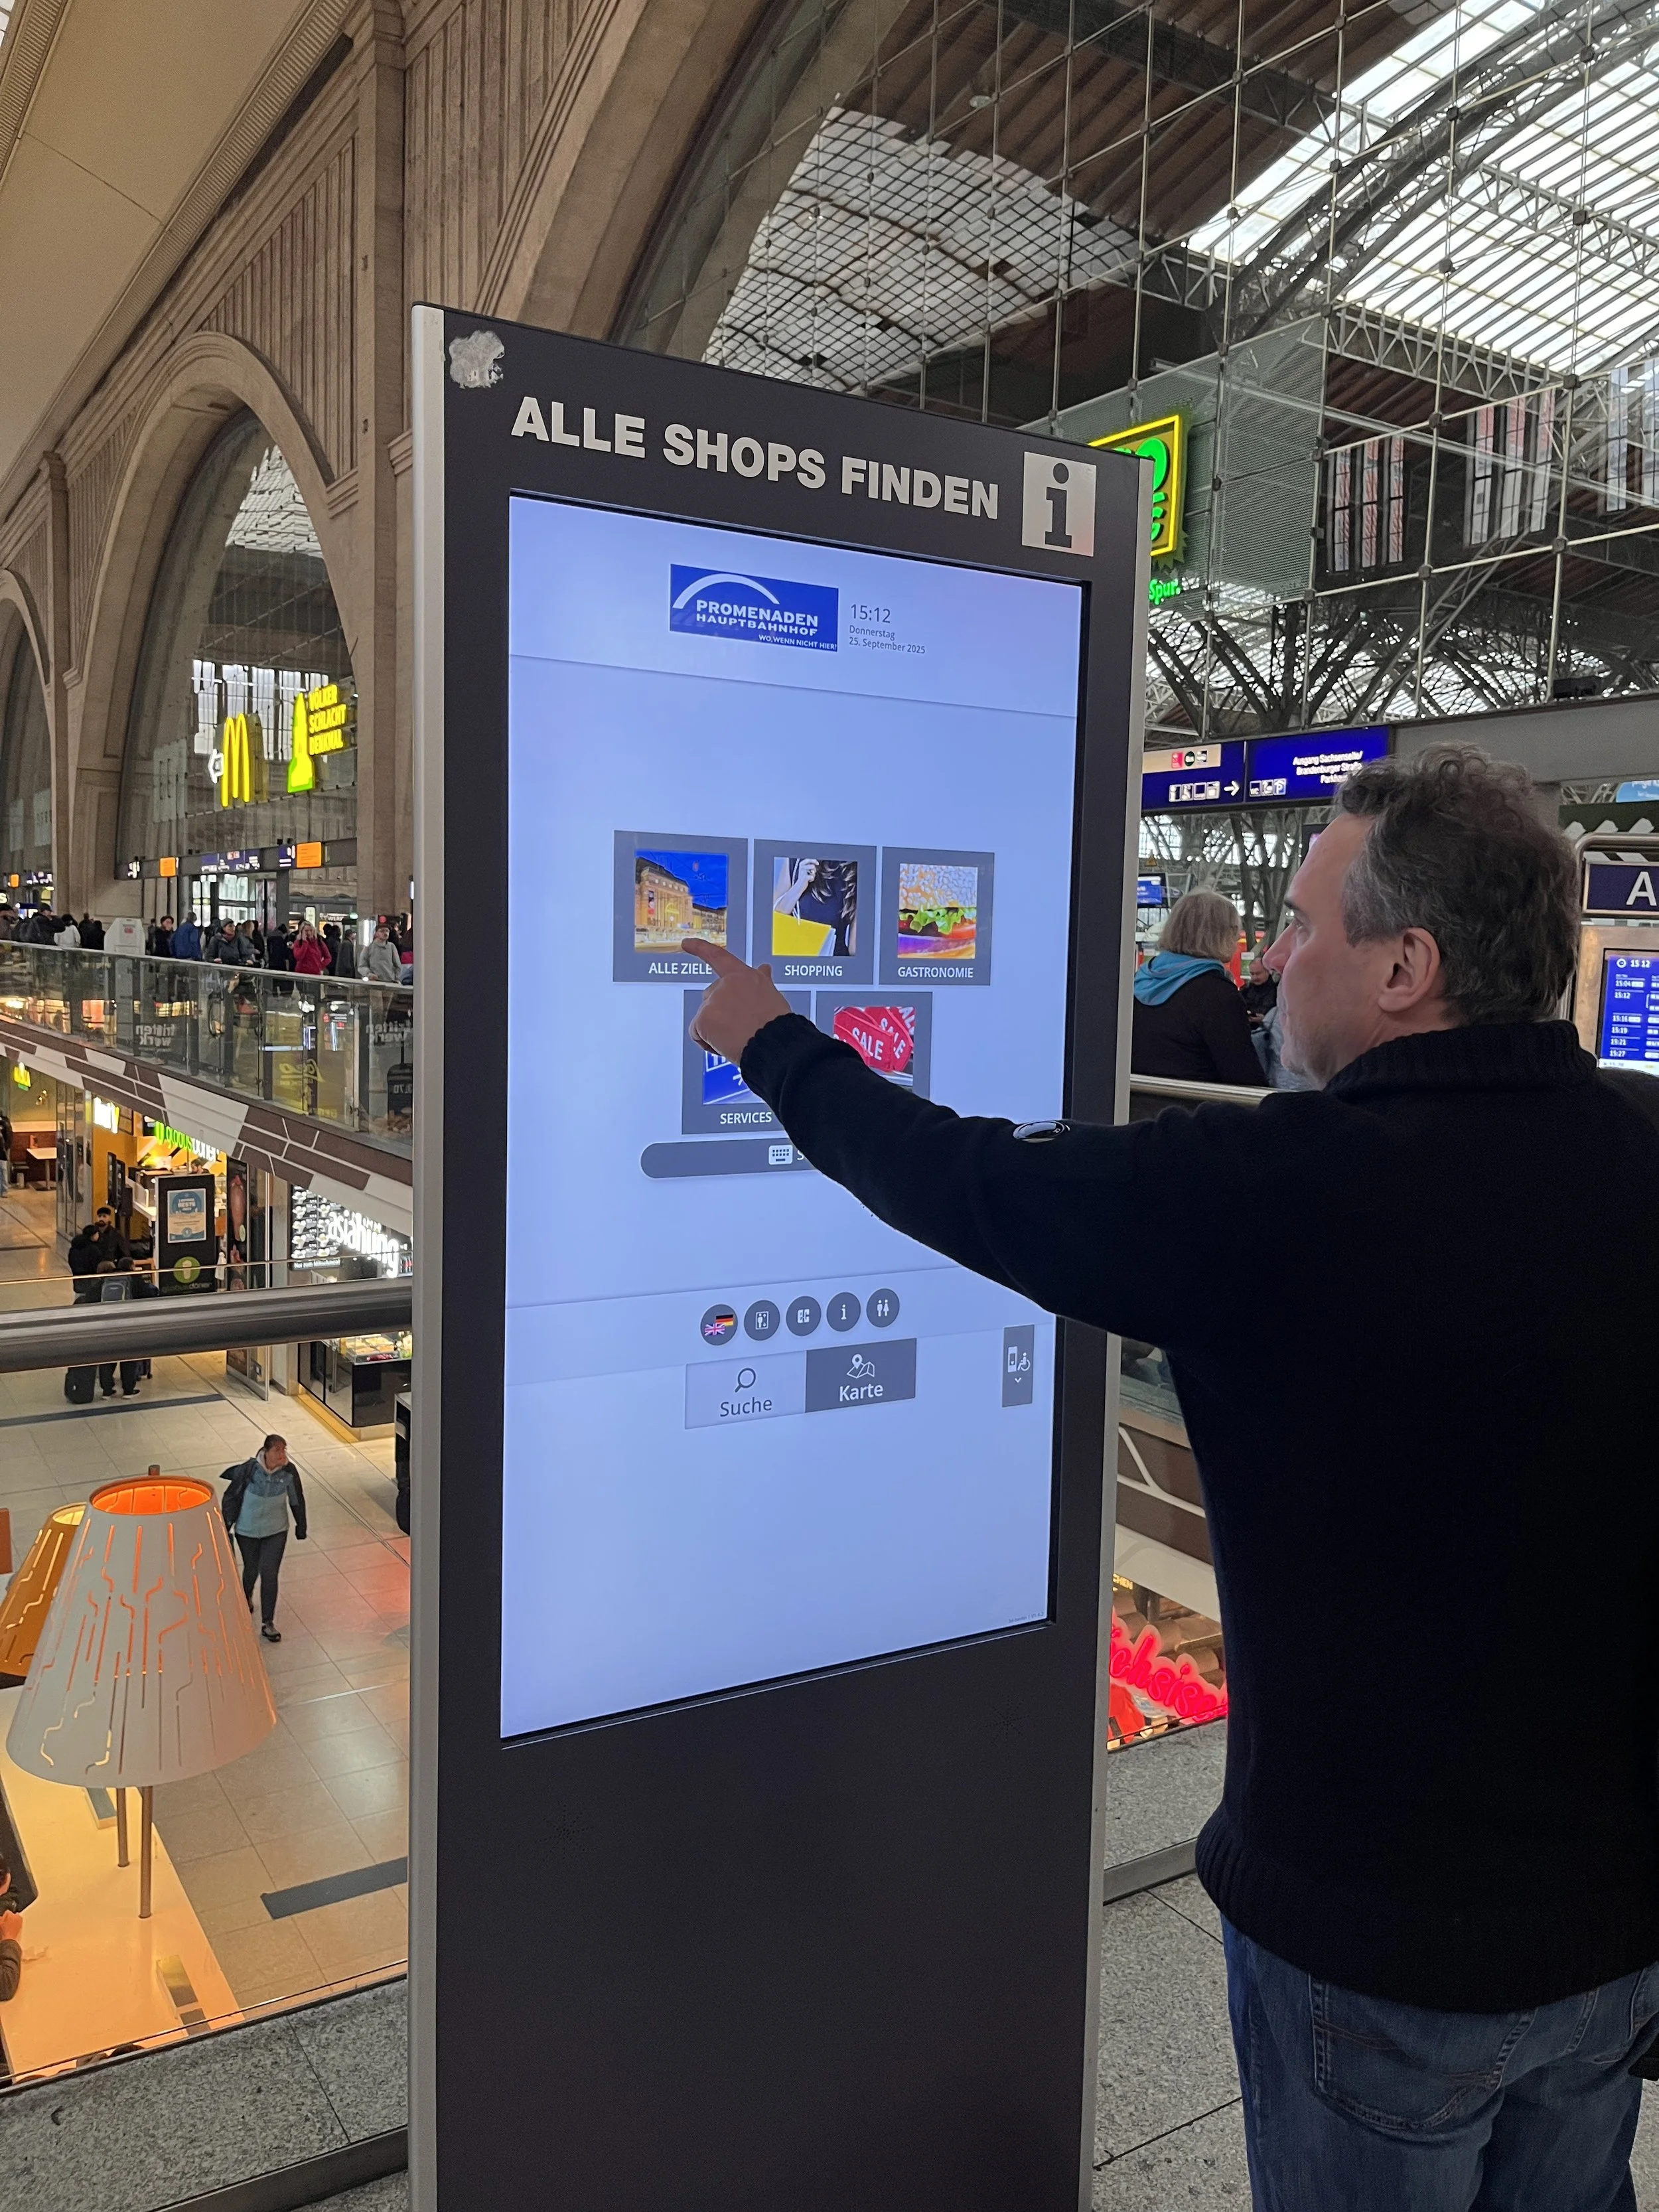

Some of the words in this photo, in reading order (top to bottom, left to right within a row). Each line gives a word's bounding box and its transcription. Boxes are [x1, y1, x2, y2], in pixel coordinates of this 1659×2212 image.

[512, 396, 645, 458] ALLE
[663, 423, 826, 489] SHOPS
[842, 456, 998, 520] FINDEN
[696, 599, 818, 627] PROMENADEN
[850, 604, 891, 624] 15:12
[696, 614, 818, 636] HAUPTBAHNHOF
[849, 625, 895, 641] Donnerstag
[796, 639, 818, 648] NICHT
[820, 642, 837, 651] HIER!
[849, 637, 861, 646] 25.
[862, 638, 905, 652] September
[906, 644, 926, 654] 2025
[1293, 757, 1319, 766] Ausgang
[1296, 765, 1340, 775] Brandenburger
[648, 962, 678, 975] ALLE
[681, 963, 712, 975] ZIELE
[784, 965, 842, 978] SHOPPING
[898, 966, 974, 979] GASTRONOMIE
[852, 1027, 884, 1061] SALE
[720, 1112, 772, 1125] SERVICES
[839, 1382, 883, 1402] Karte
[719, 1397, 772, 1418] Suche
